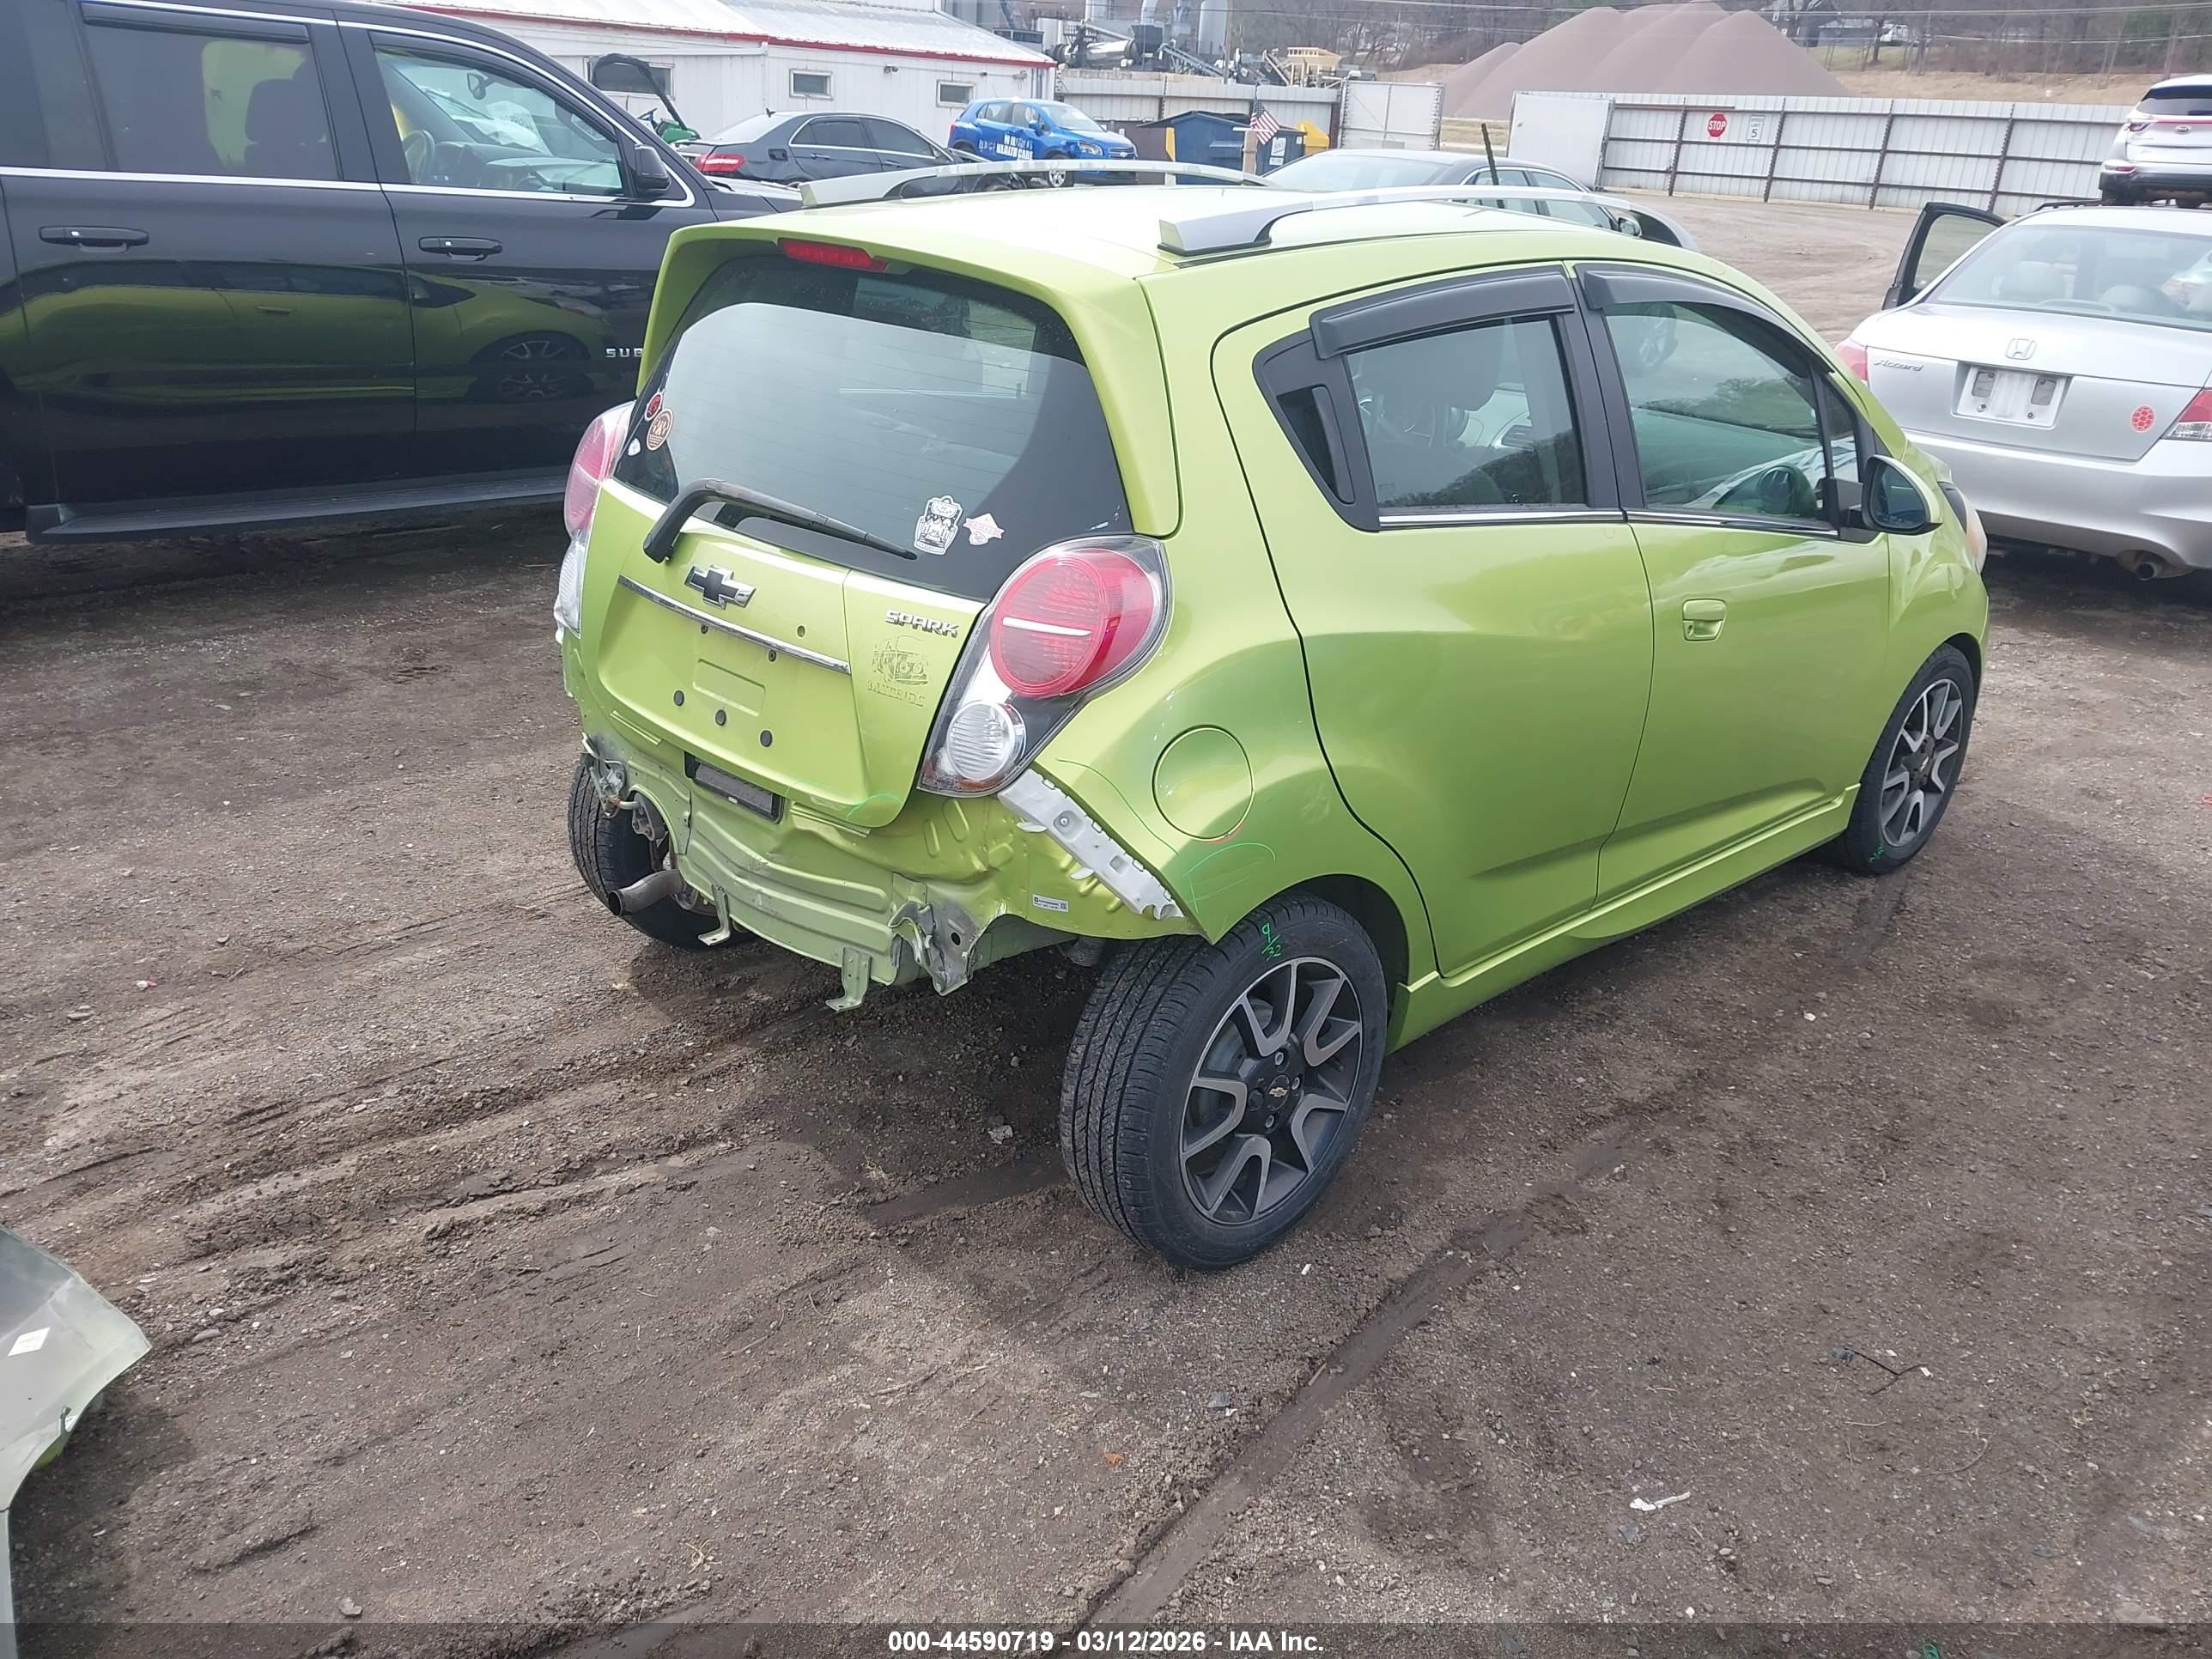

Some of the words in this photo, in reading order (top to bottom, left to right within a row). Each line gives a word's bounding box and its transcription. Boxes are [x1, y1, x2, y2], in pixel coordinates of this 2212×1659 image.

[1708, 119, 1727, 131] STOP
[1751, 129, 1758, 137] 5
[1874, 360, 1924, 372] Accord
[885, 610, 959, 638] SPARK
